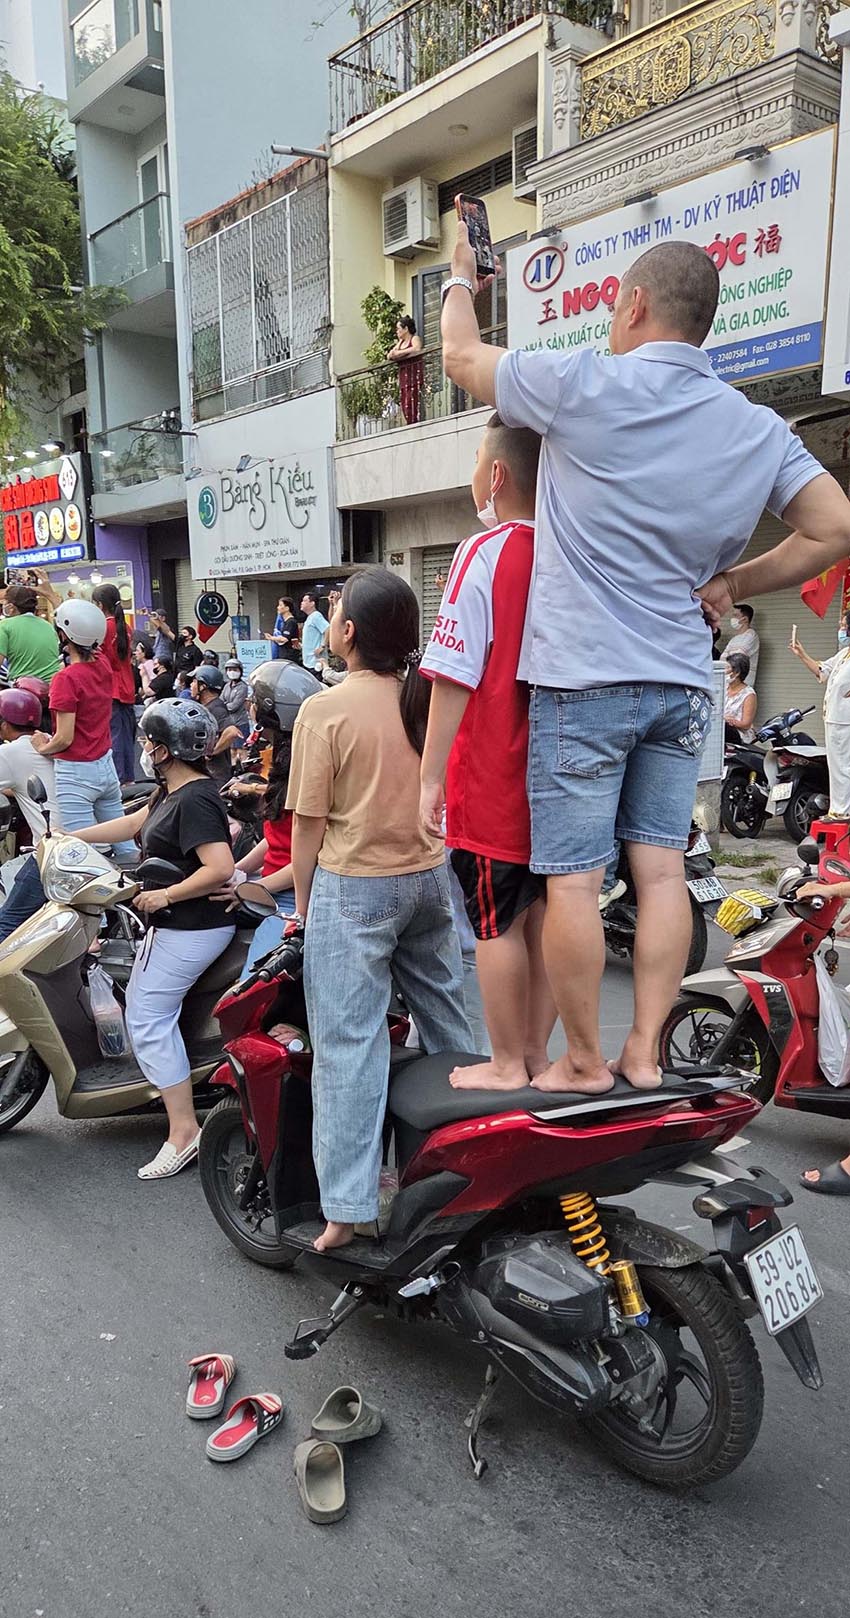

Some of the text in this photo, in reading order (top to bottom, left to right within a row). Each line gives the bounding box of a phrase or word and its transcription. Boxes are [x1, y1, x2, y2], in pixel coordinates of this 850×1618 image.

[575, 241, 602, 266] CÔNG
[604, 235, 619, 256] TY
[622, 223, 651, 250] TNHH
[654, 216, 672, 239] TM
[684, 205, 701, 229] DV
[704, 194, 722, 222] KỸ
[726, 180, 767, 214] THUẬT
[770, 168, 801, 199] ĐIỆN
[753, 223, 783, 258] 福
[562, 233, 747, 318] NGỌ ỚC
[718, 267, 793, 305] ÔNG NGHIỆP
[537, 298, 558, 325] 玉
[712, 300, 790, 336] VÀ GIA DỤNG.
[546, 332, 565, 350] SẢN
[567, 322, 592, 347] XUẤT
[435, 614, 458, 633] SIT
[432, 630, 465, 653] NDA
[762, 984, 782, 993] TVS
[765, 1266, 819, 1328] 206.84
